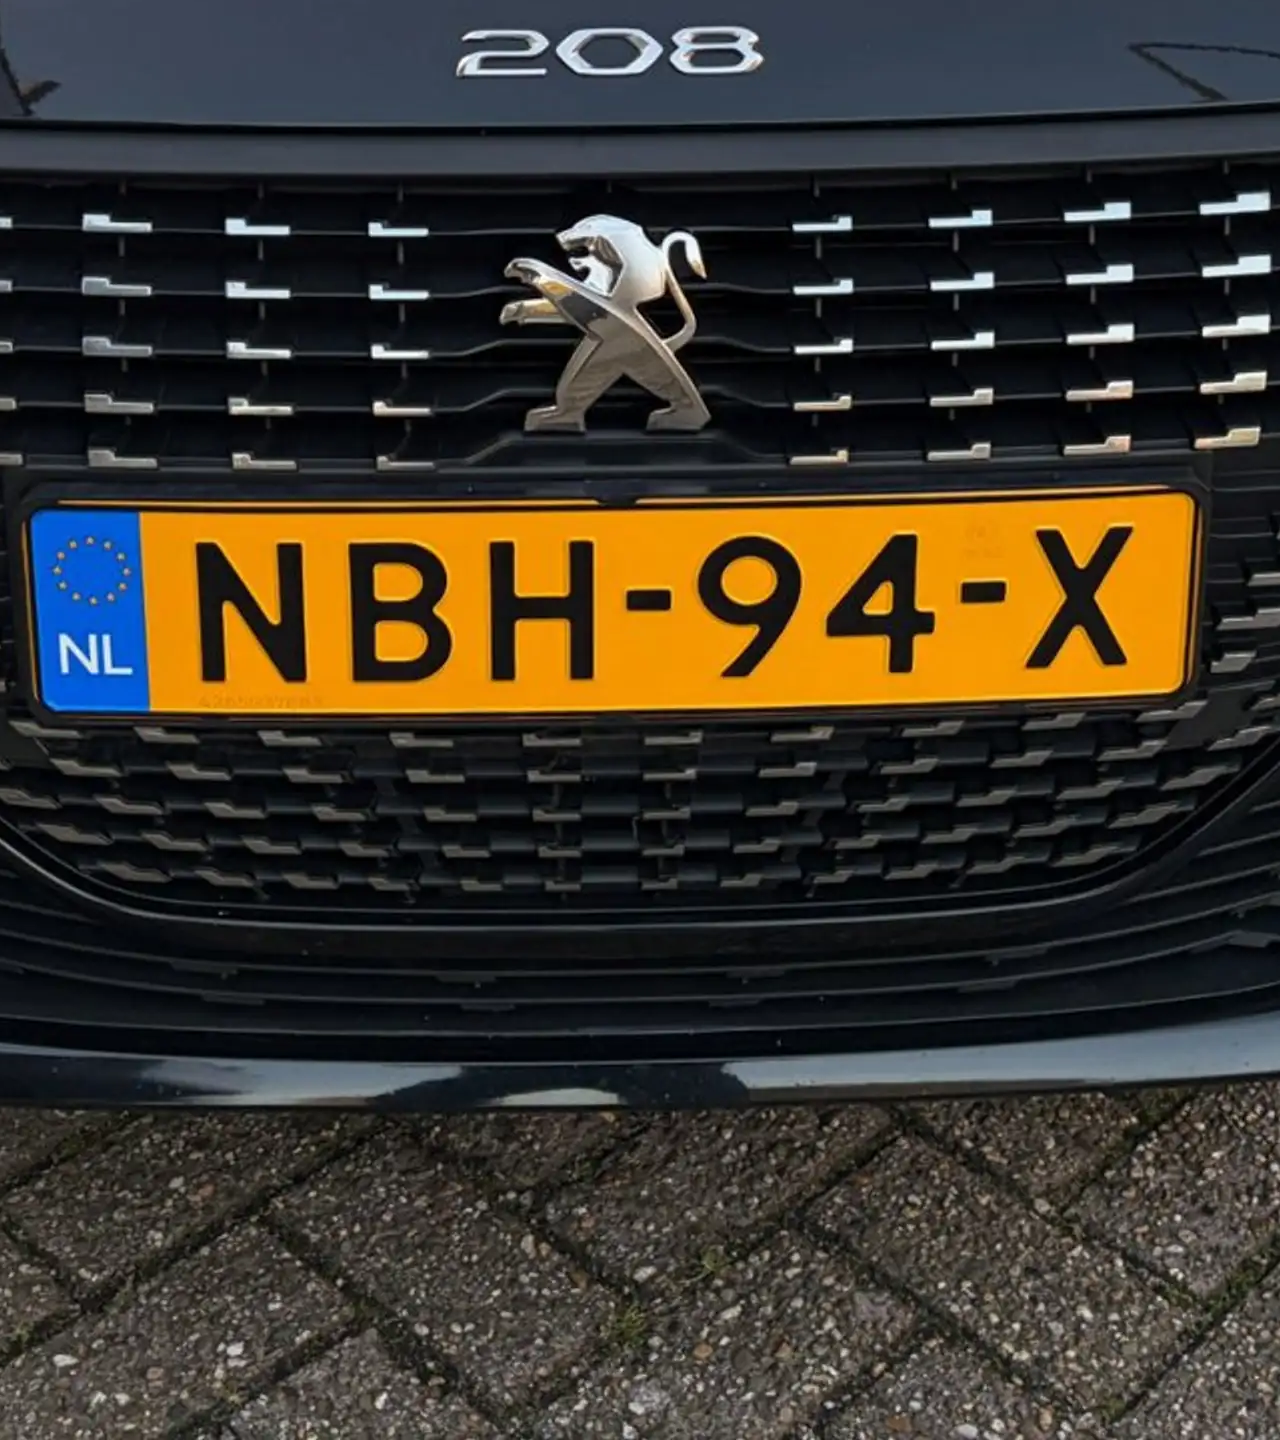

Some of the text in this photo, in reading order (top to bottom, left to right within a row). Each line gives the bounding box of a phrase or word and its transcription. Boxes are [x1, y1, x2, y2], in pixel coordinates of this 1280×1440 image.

[456, 25, 765, 79] 208
[195, 524, 1135, 684] NBH-94-X
[58, 632, 135, 676] NL
